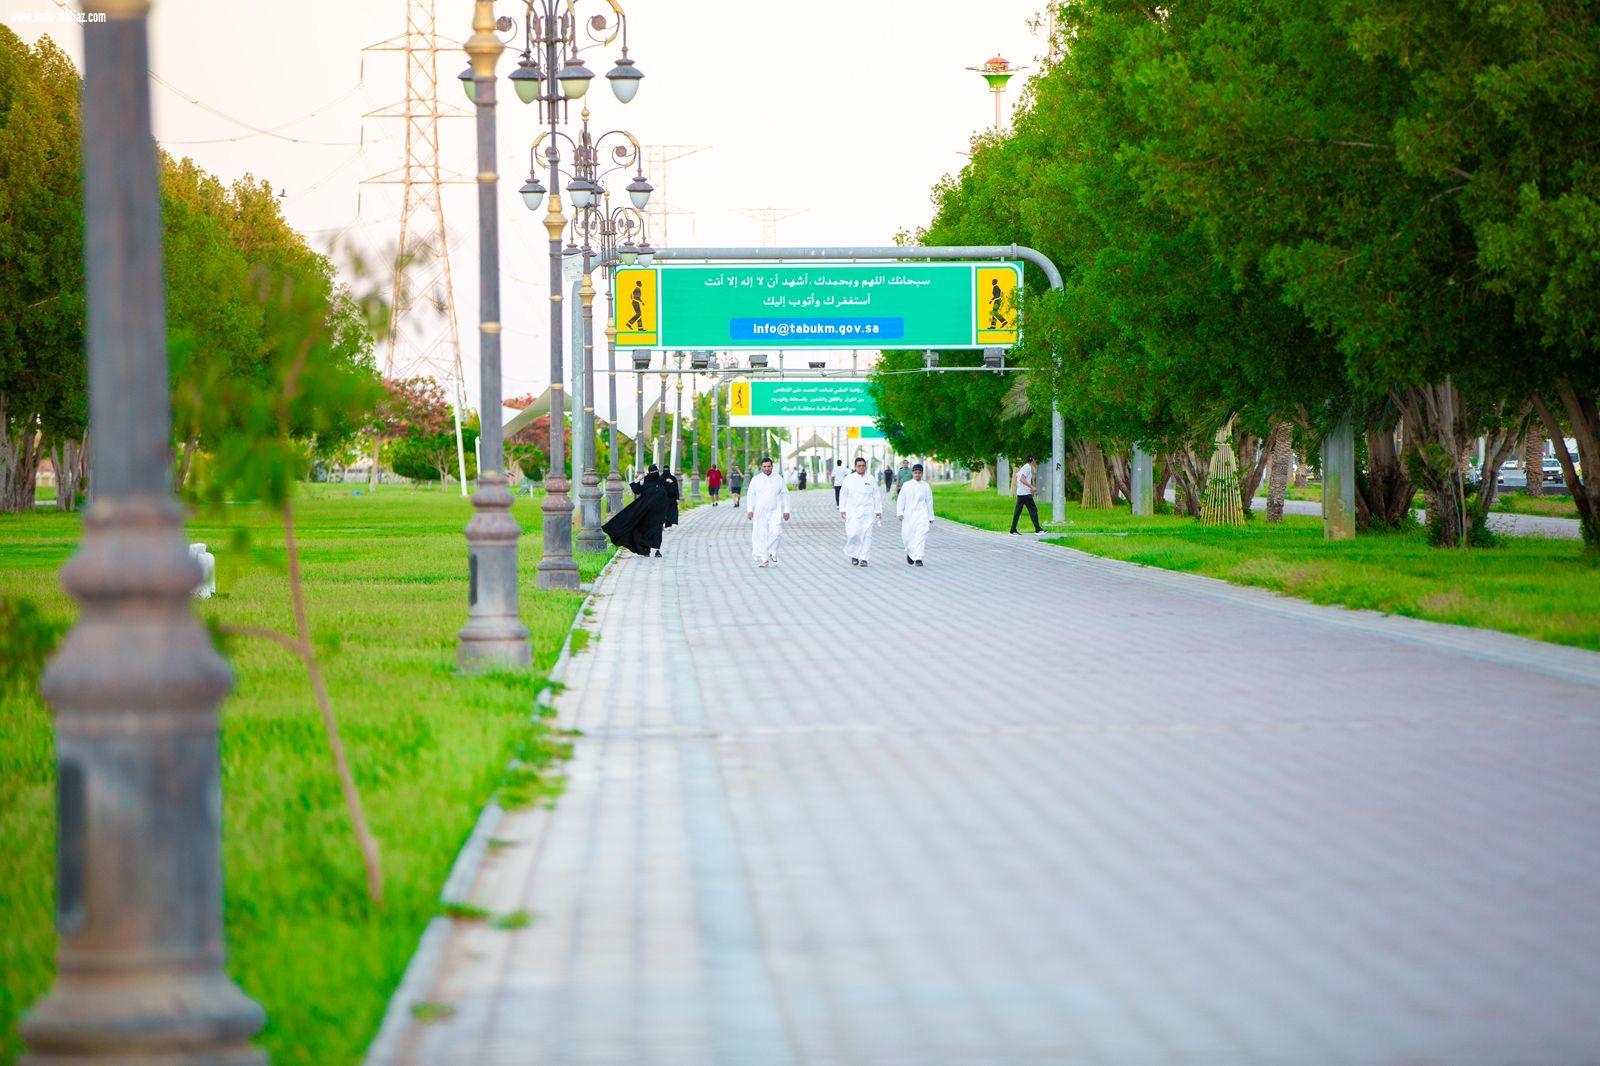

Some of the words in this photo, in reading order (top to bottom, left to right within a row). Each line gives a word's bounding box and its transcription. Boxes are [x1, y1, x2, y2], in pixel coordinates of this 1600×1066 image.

[704, 273, 724, 286] أنت
[726, 275, 738, 288] إلا
[740, 275, 754, 288] إله
[756, 276, 765, 286] لا
[766, 273, 779, 288] أن
[781, 273, 809, 288] أشهد
[861, 276, 886, 290] اللهم
[887, 276, 931, 289] سبحانك
[762, 295, 786, 307] إليك
[788, 293, 821, 308] وأتوب
[822, 292, 871, 307] أستغفرك
